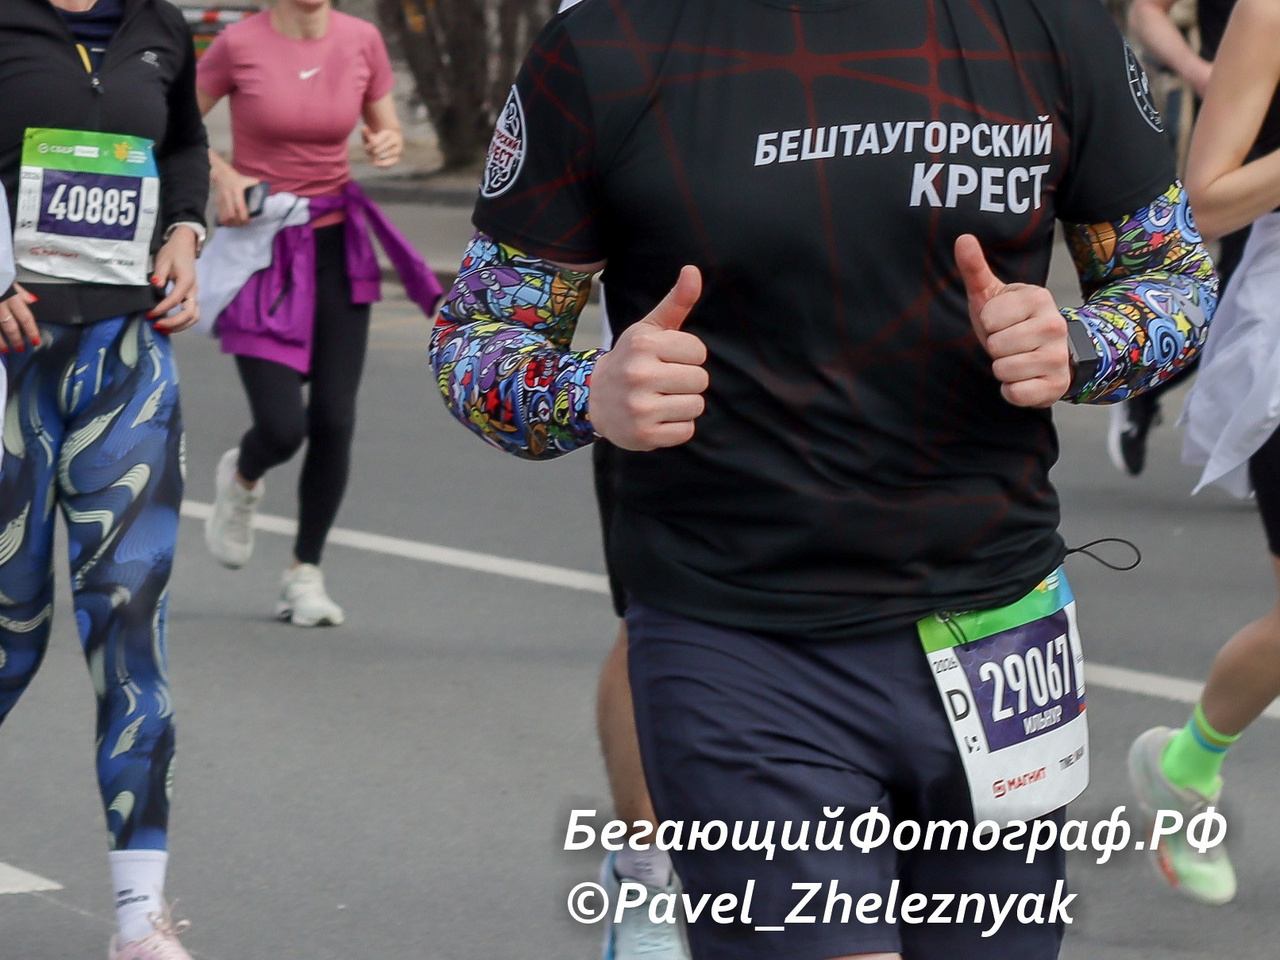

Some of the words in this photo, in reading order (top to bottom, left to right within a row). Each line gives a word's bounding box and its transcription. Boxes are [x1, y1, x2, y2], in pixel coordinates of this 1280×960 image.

[753, 114, 1053, 167] БЕШТАУГОРСКИЙ
[47, 183, 138, 227] 40885
[909, 162, 1051, 214] КРЕСТ
[979, 633, 1071, 723] 29067
[945, 688, 971, 721] D
